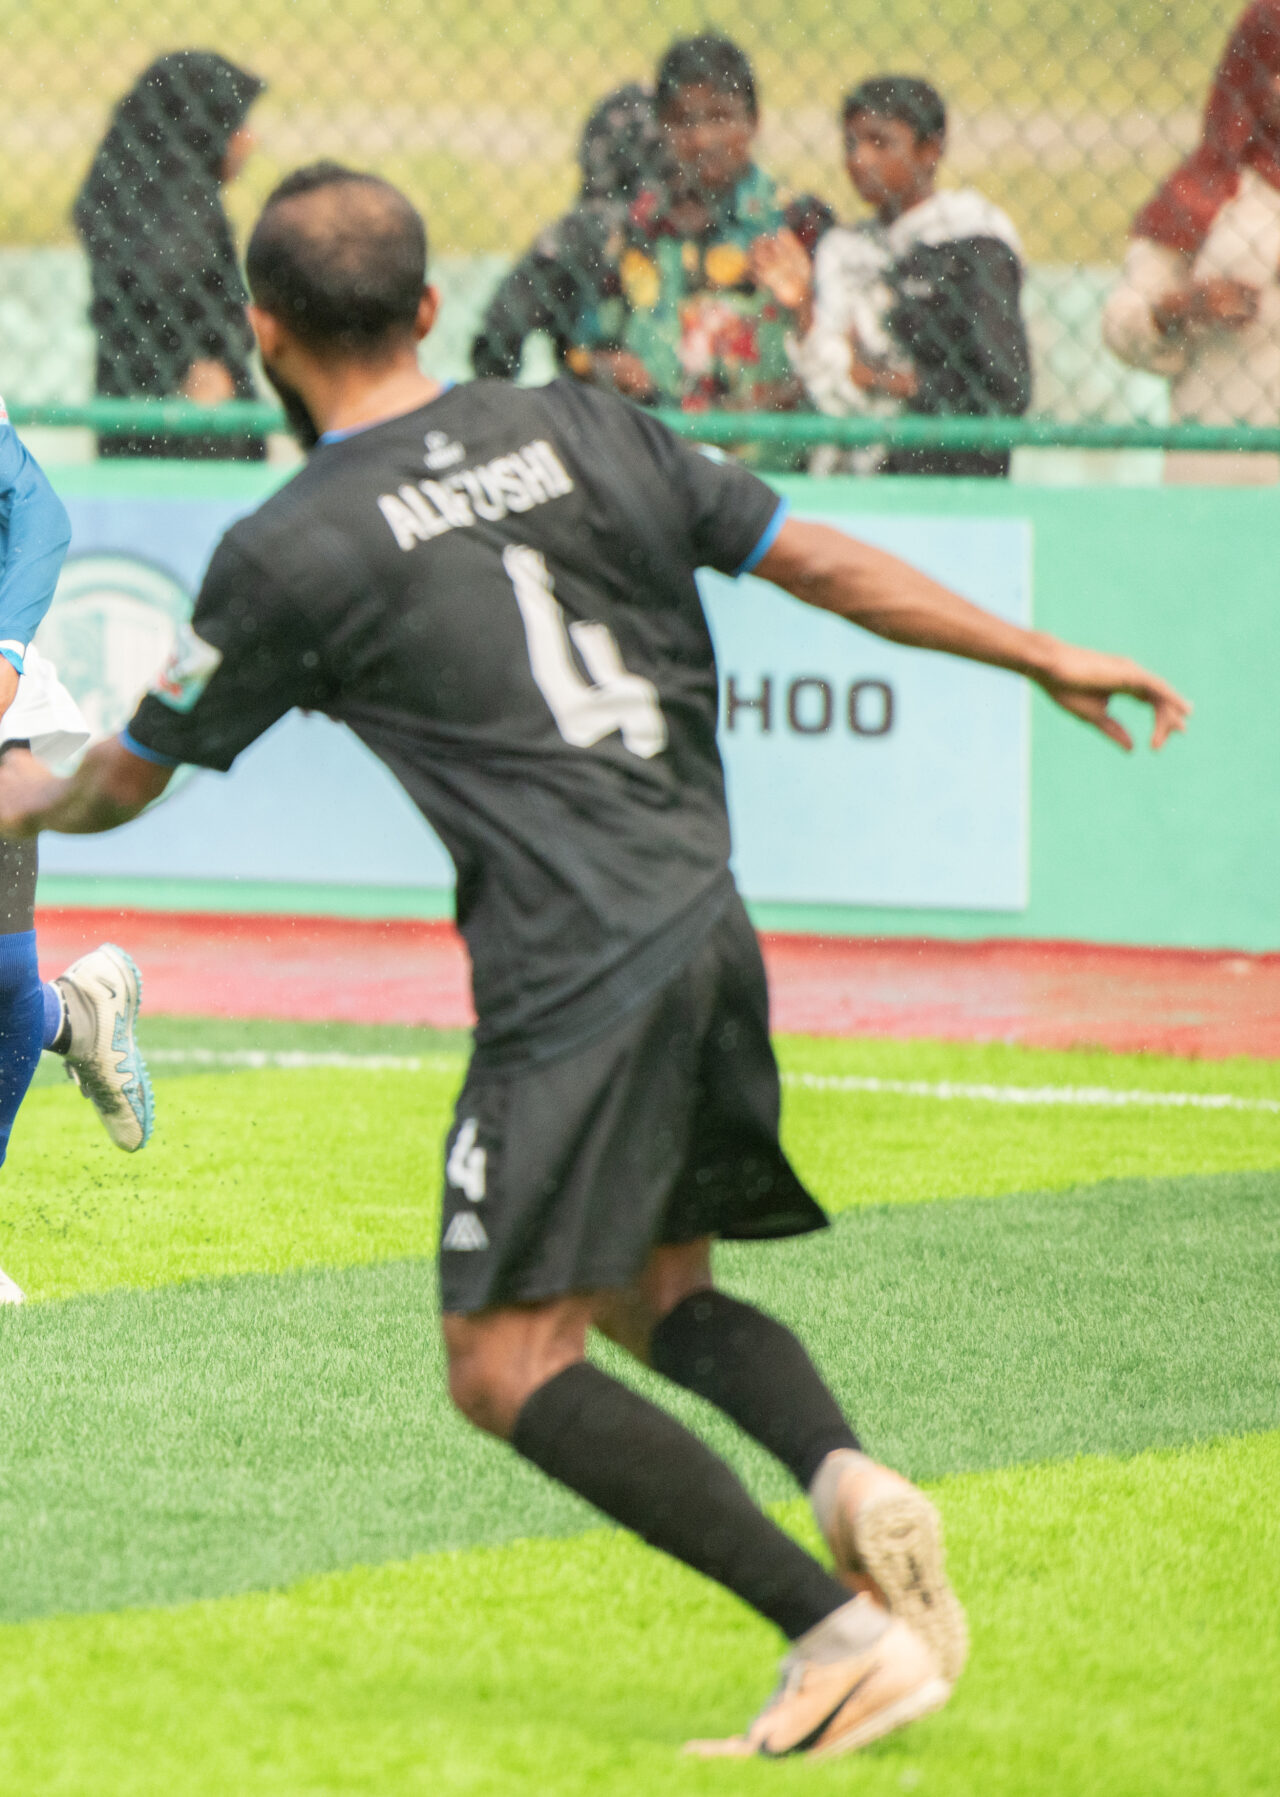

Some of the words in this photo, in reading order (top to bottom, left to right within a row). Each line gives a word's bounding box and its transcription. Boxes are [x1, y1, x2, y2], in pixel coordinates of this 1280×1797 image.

[503, 544, 669, 760] 4
[725, 672, 897, 738] HOO
[446, 1117, 488, 1203] 4
